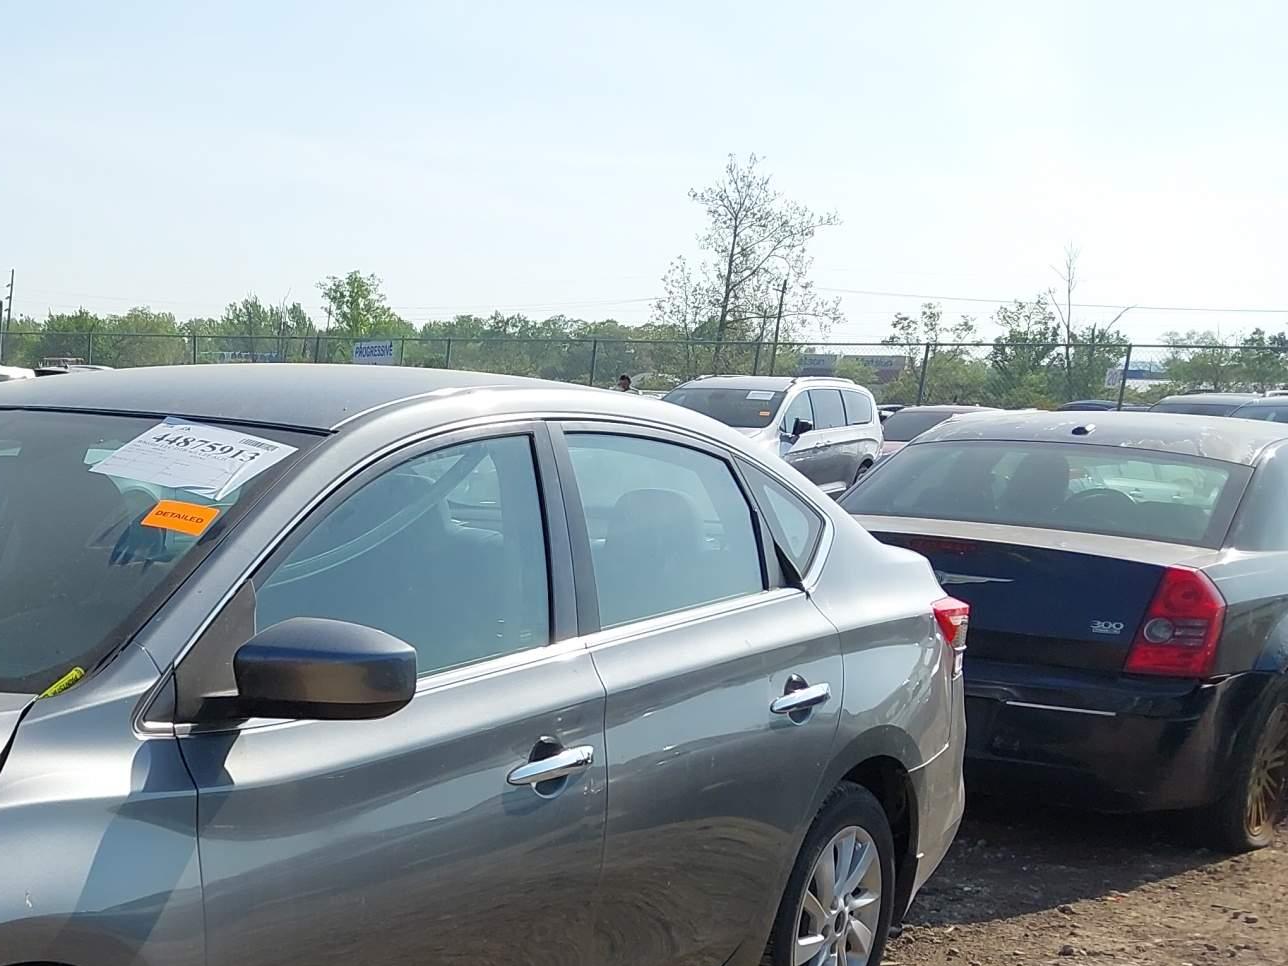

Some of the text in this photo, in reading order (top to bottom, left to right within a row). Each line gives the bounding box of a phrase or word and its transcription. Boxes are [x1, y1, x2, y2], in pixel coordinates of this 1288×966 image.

[354, 343, 393, 358] PROGRESSIVE
[152, 433, 260, 463] 44875913
[155, 509, 204, 524] DETAILED
[1090, 620, 1124, 630] 300
